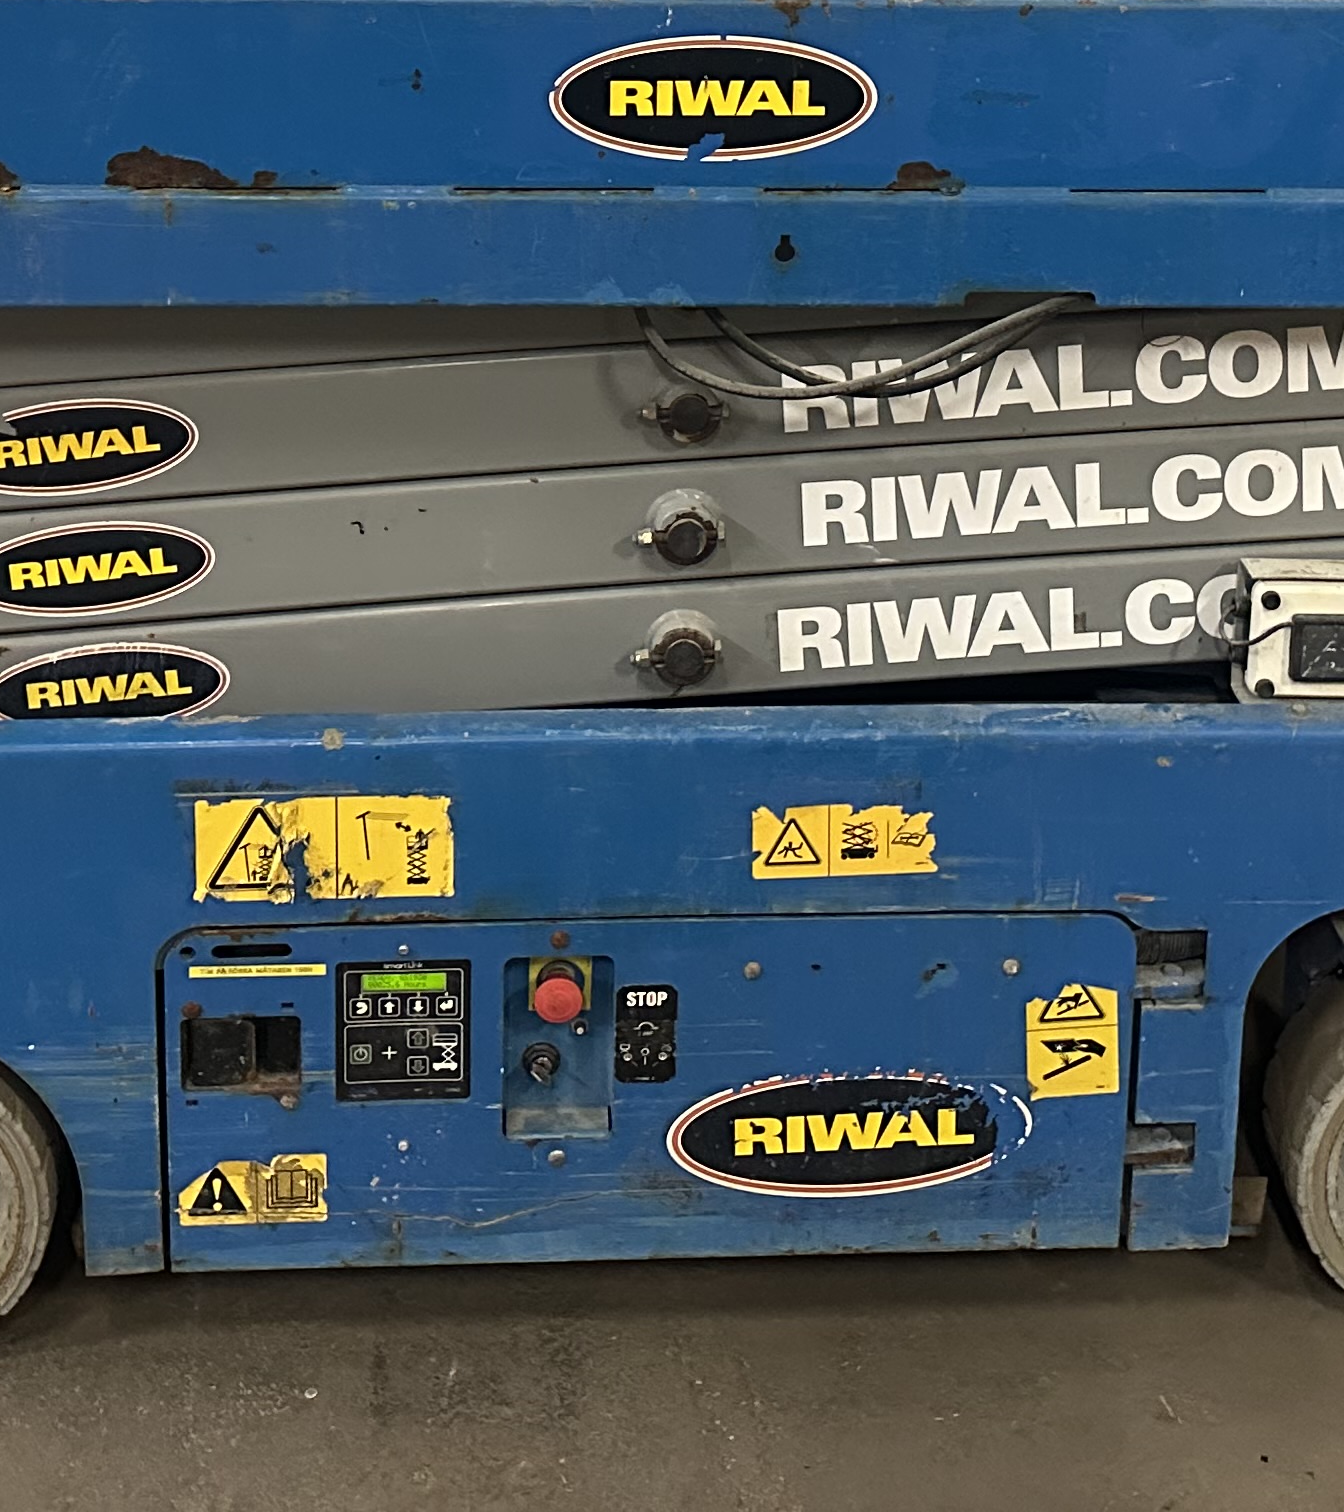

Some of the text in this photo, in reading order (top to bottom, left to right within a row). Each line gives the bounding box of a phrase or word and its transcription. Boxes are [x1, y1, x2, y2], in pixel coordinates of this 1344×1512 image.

[609, 79, 826, 117] RIWAL
[8, 547, 178, 591] RIWAL
[25, 669, 193, 710] RIWAL
[626, 991, 668, 1007] STOP
[734, 1108, 975, 1157] RIWAL
